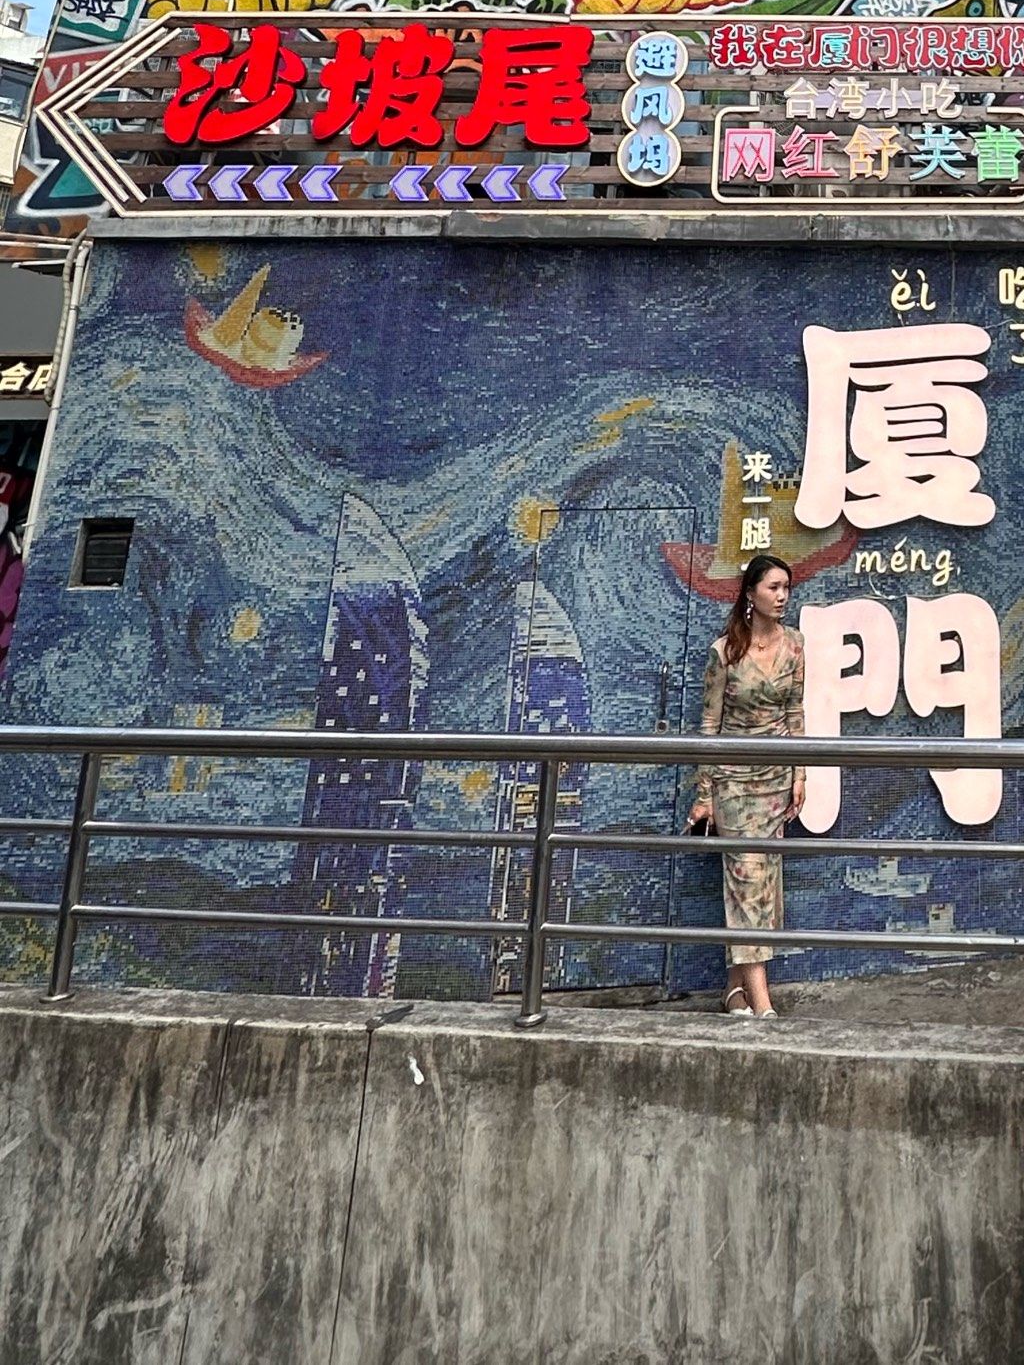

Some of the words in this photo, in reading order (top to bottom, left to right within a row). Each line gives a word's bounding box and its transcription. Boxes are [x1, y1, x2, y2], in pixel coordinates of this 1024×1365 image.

[163, 23, 595, 147] 沙坡尾
[628, 39, 679, 177] 避风坞
[783, 77, 965, 120] 台湾小吃
[739, 450, 774, 572] 来一腿
